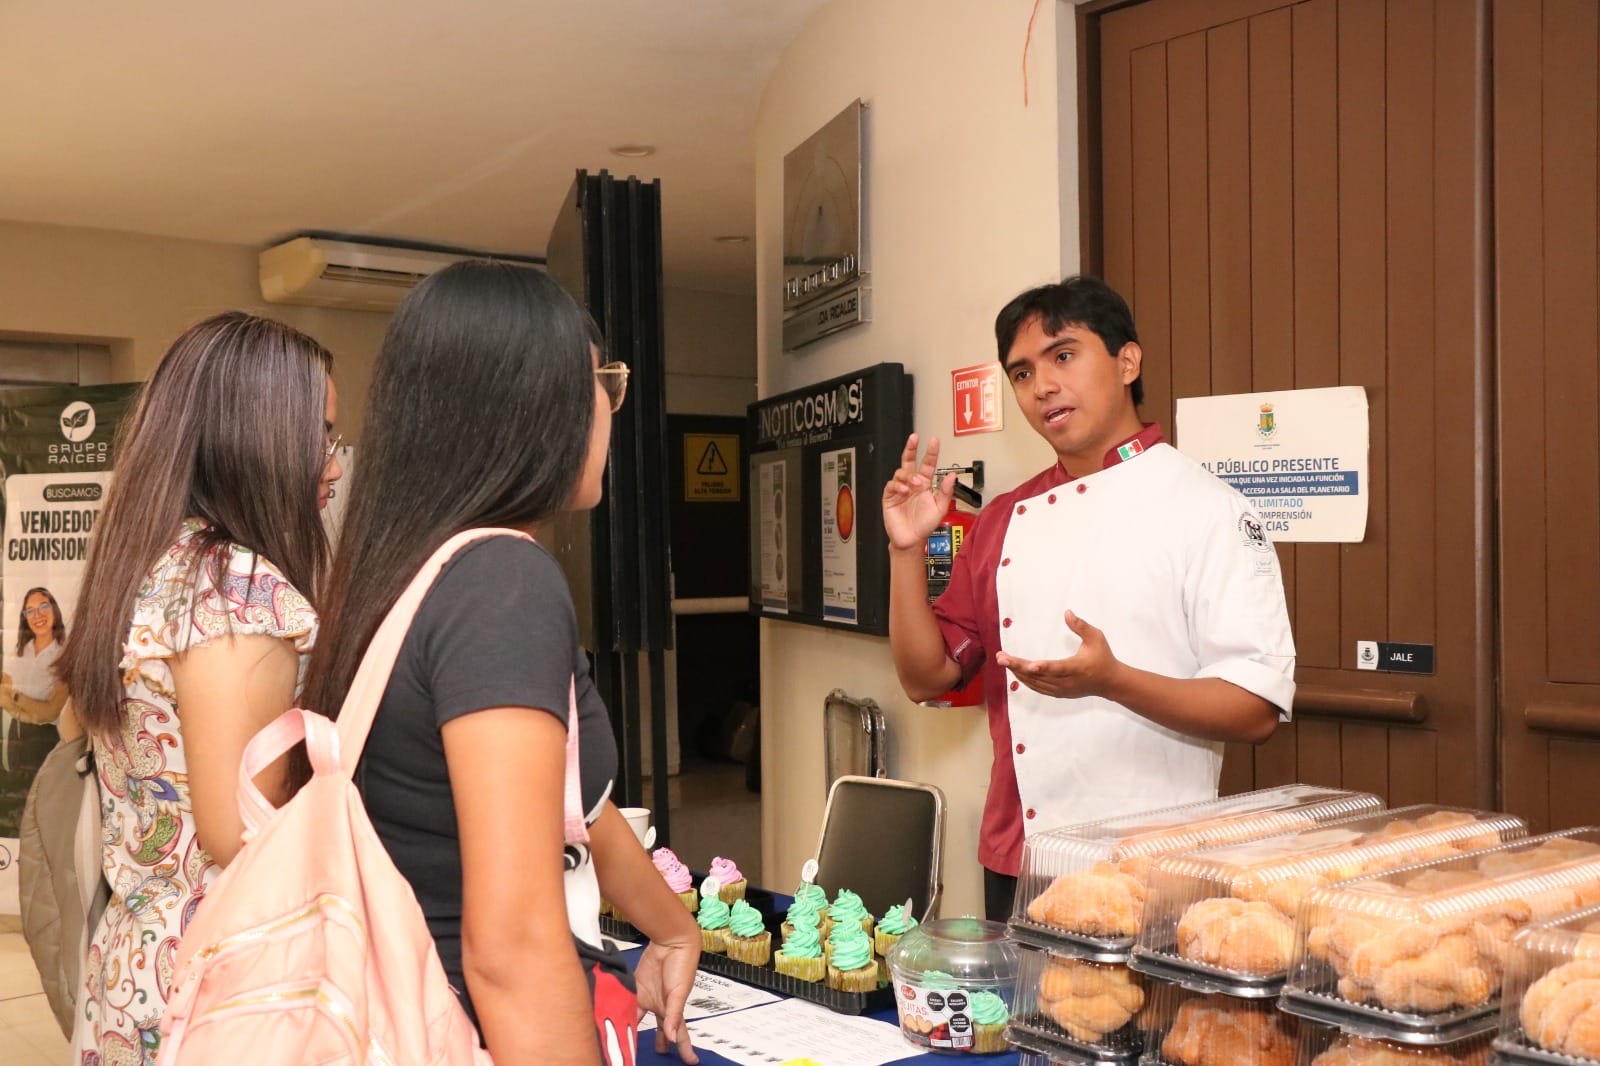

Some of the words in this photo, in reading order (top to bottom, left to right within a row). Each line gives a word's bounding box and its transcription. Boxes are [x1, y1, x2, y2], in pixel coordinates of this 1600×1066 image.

[48, 442, 108, 454] GRUPO
[48, 452, 106, 464] RAÍCES
[1217, 458, 1269, 474] PÚBLICO
[1272, 457, 1339, 472] PRESENTE
[1238, 477, 1252, 486] QUE
[1252, 476, 1266, 484] UNA
[1266, 475, 1278, 483] VEZ
[1278, 475, 1306, 483] INICIADA
[1315, 473, 1345, 482] FUNCIÓN
[46, 487, 101, 499] BUSCAMOS
[1258, 498, 1304, 508] LIMITADO
[1390, 653, 1413, 662] JALE
